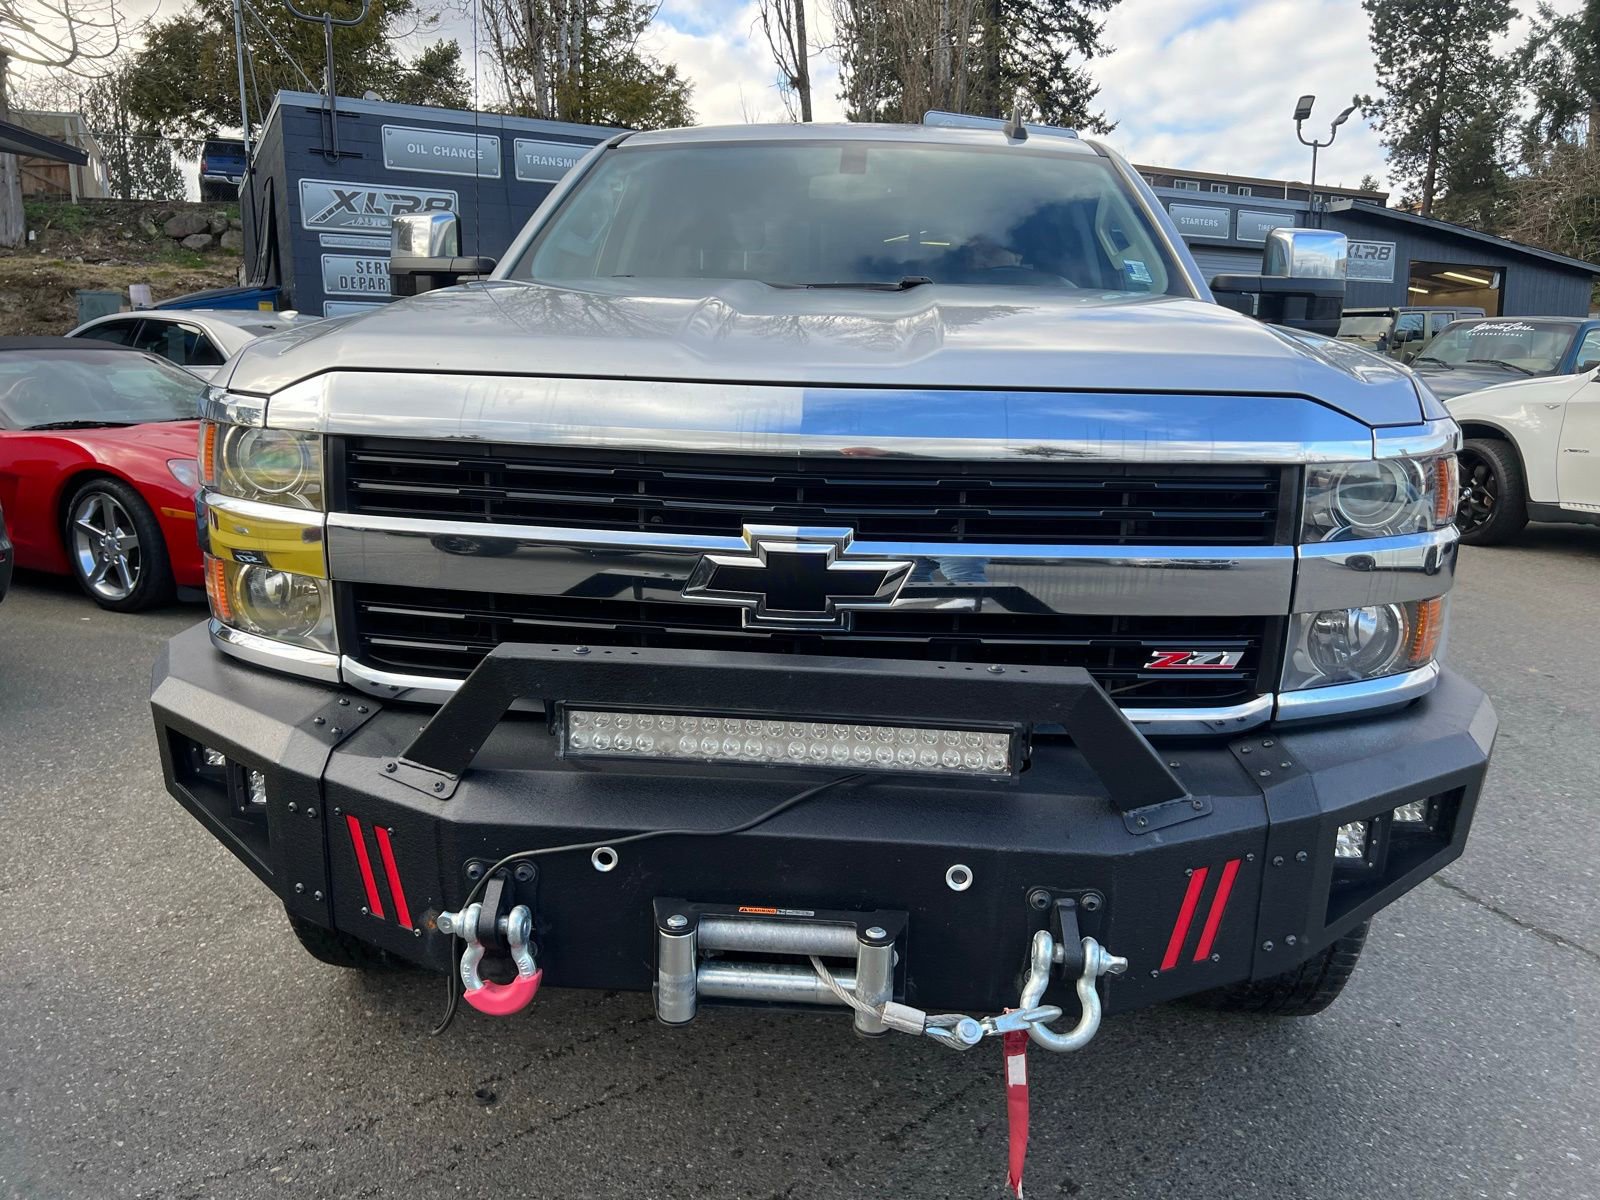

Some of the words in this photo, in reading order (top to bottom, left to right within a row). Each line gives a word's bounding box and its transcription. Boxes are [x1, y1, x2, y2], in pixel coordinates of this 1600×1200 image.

[407, 143, 428, 154] OIL
[433, 146, 484, 159] CHANGE
[525, 154, 579, 168] TRANSMI
[1181, 216, 1219, 227] STARTERS
[1143, 650, 1245, 670] Z71
